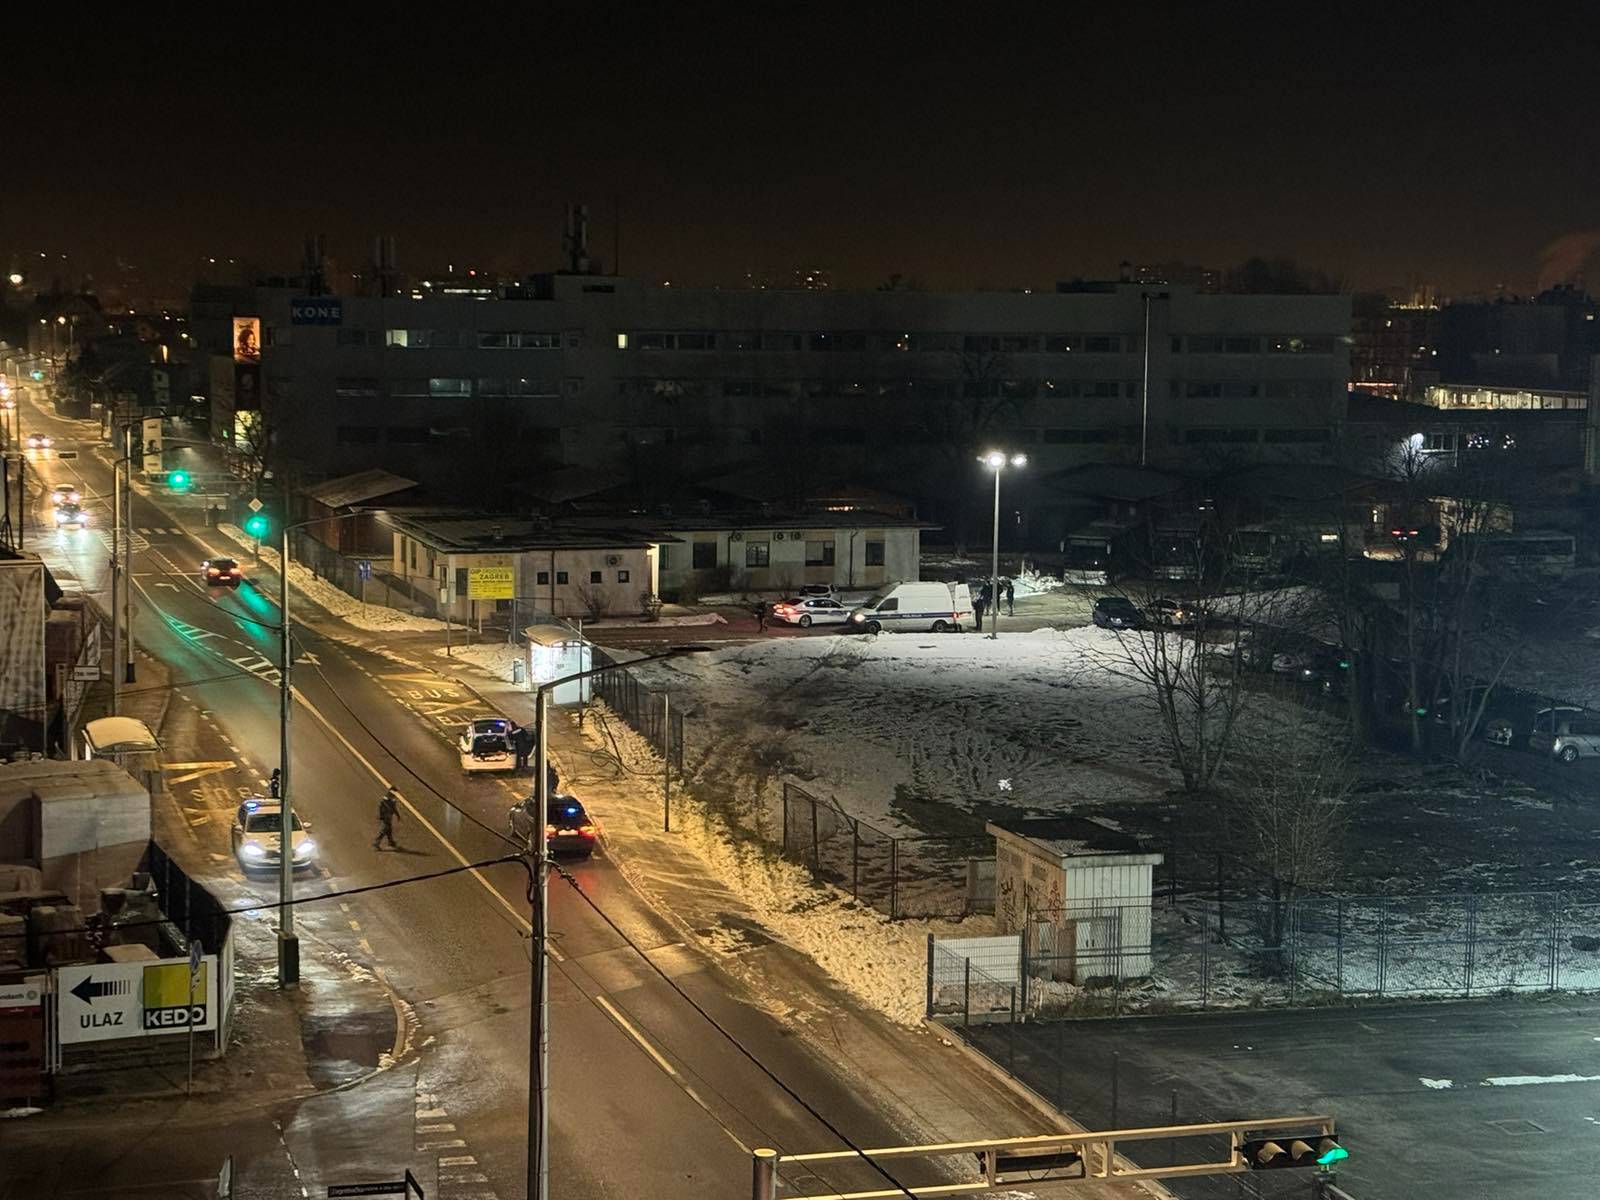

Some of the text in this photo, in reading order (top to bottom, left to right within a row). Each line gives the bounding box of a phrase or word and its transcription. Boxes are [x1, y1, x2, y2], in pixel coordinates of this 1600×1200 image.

[293, 307, 340, 318] KONE
[407, 689, 459, 699] BUS
[436, 715, 472, 726] BU
[80, 1012, 123, 1029] ULAZ
[146, 1007, 205, 1027] KEDO
